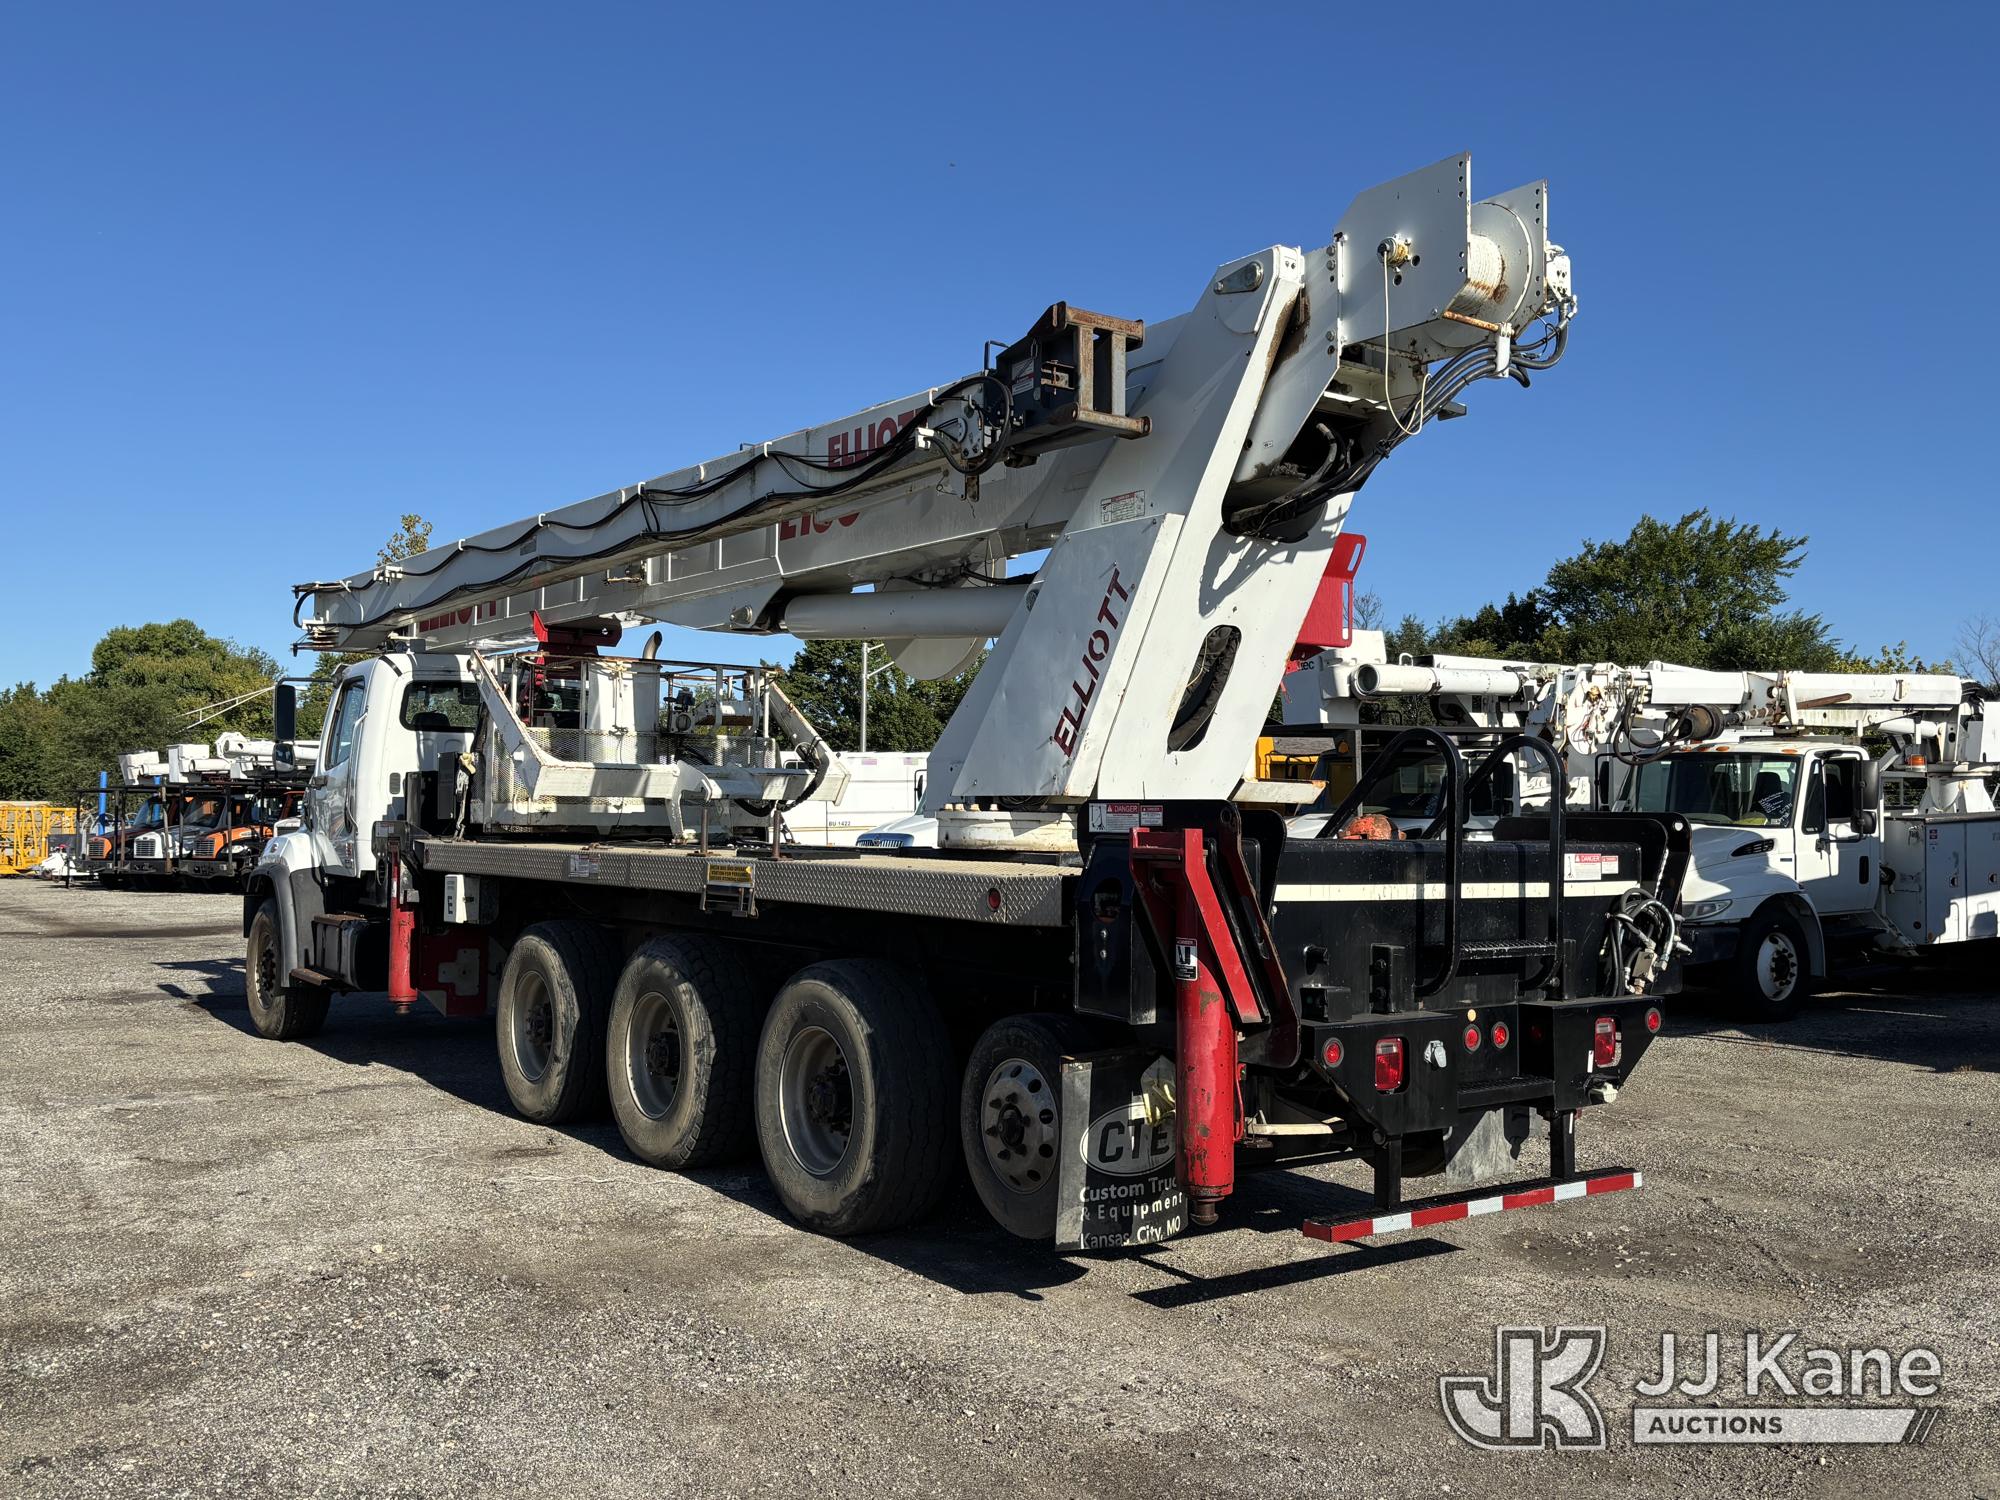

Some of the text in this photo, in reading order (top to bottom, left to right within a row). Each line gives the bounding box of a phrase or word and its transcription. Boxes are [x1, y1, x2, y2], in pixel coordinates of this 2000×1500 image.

[1054, 568, 1128, 757] ELLIOTT
[1098, 1118, 1170, 1163] CTE
[1080, 1176, 1177, 1203] Custom Truc
[1098, 1192, 1183, 1222] Equipment
[1080, 1216, 1181, 1249] Kansas City, MO
